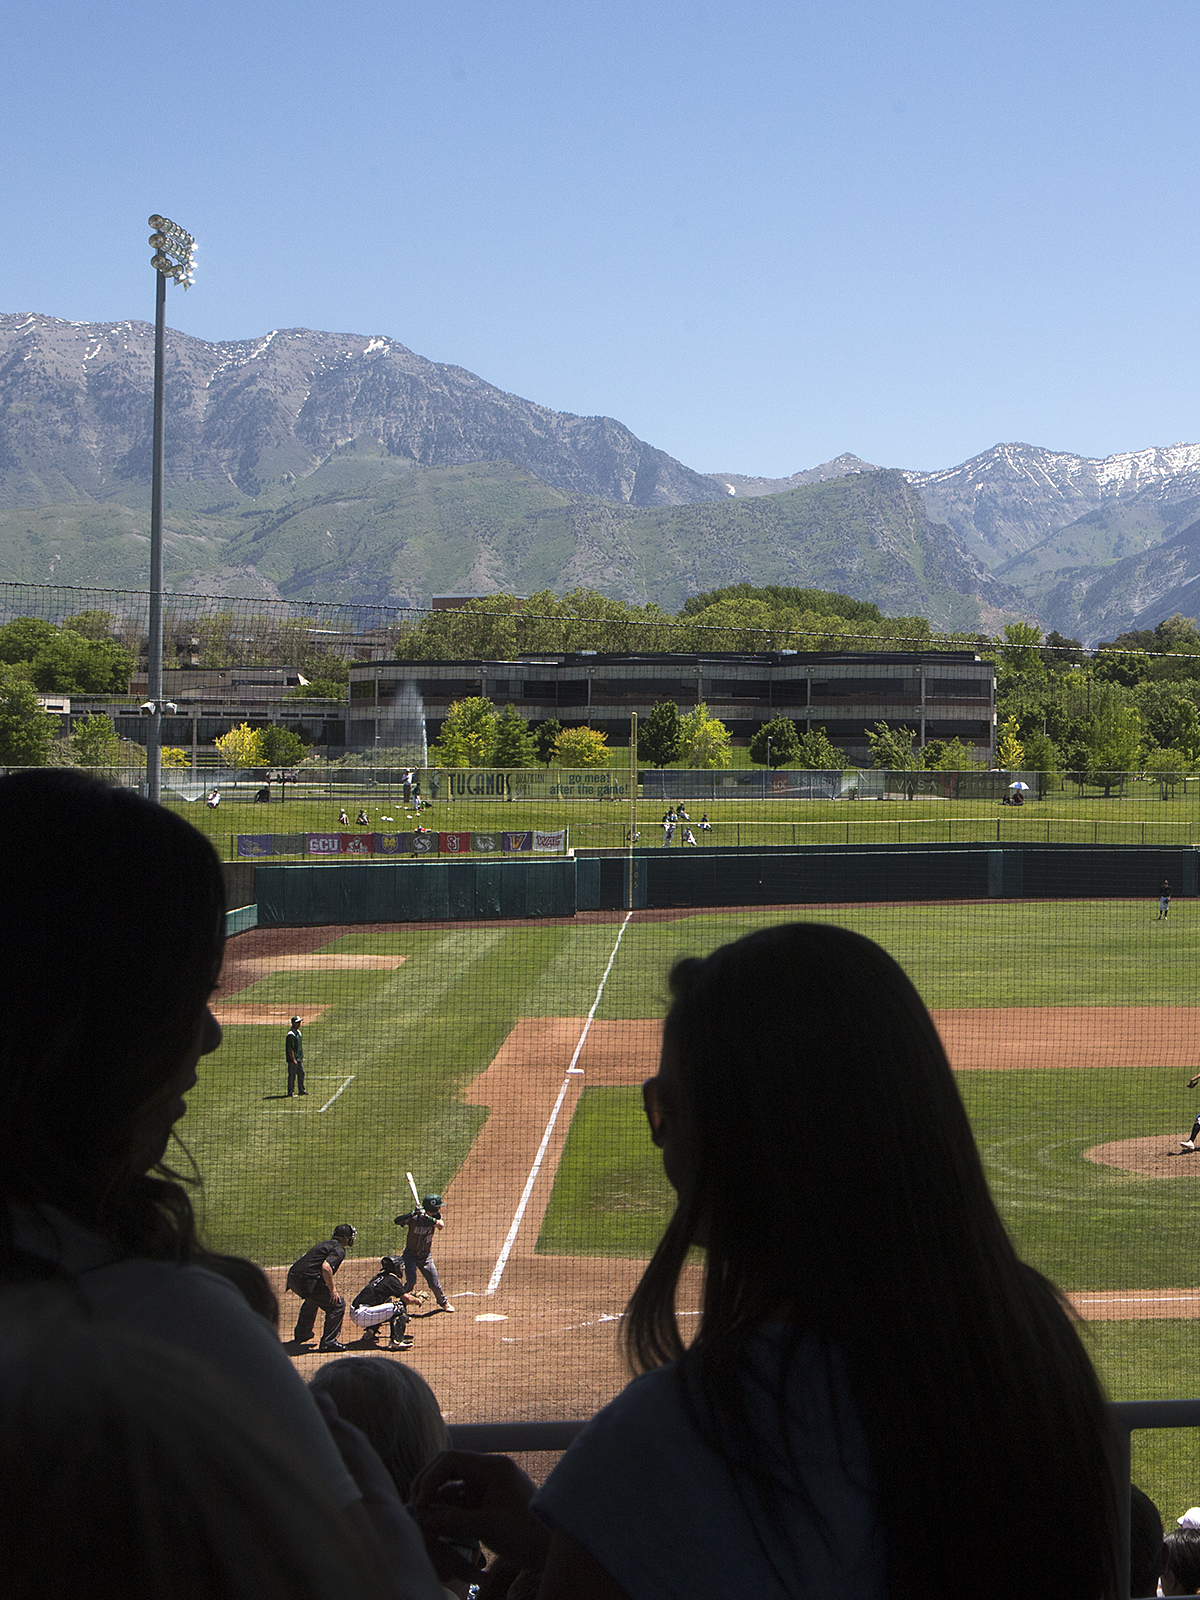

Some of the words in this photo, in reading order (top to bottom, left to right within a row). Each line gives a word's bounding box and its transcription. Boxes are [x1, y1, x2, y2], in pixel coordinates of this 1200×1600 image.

[448, 773, 511, 795] TUCANOS
[568, 774, 582, 785] go
[584, 773, 610, 783] meat
[550, 784, 574, 795] after
[577, 784, 594, 795] the
[597, 784, 628, 797] game!
[309, 838, 338, 851] GCU
[536, 834, 562, 847] WAC
